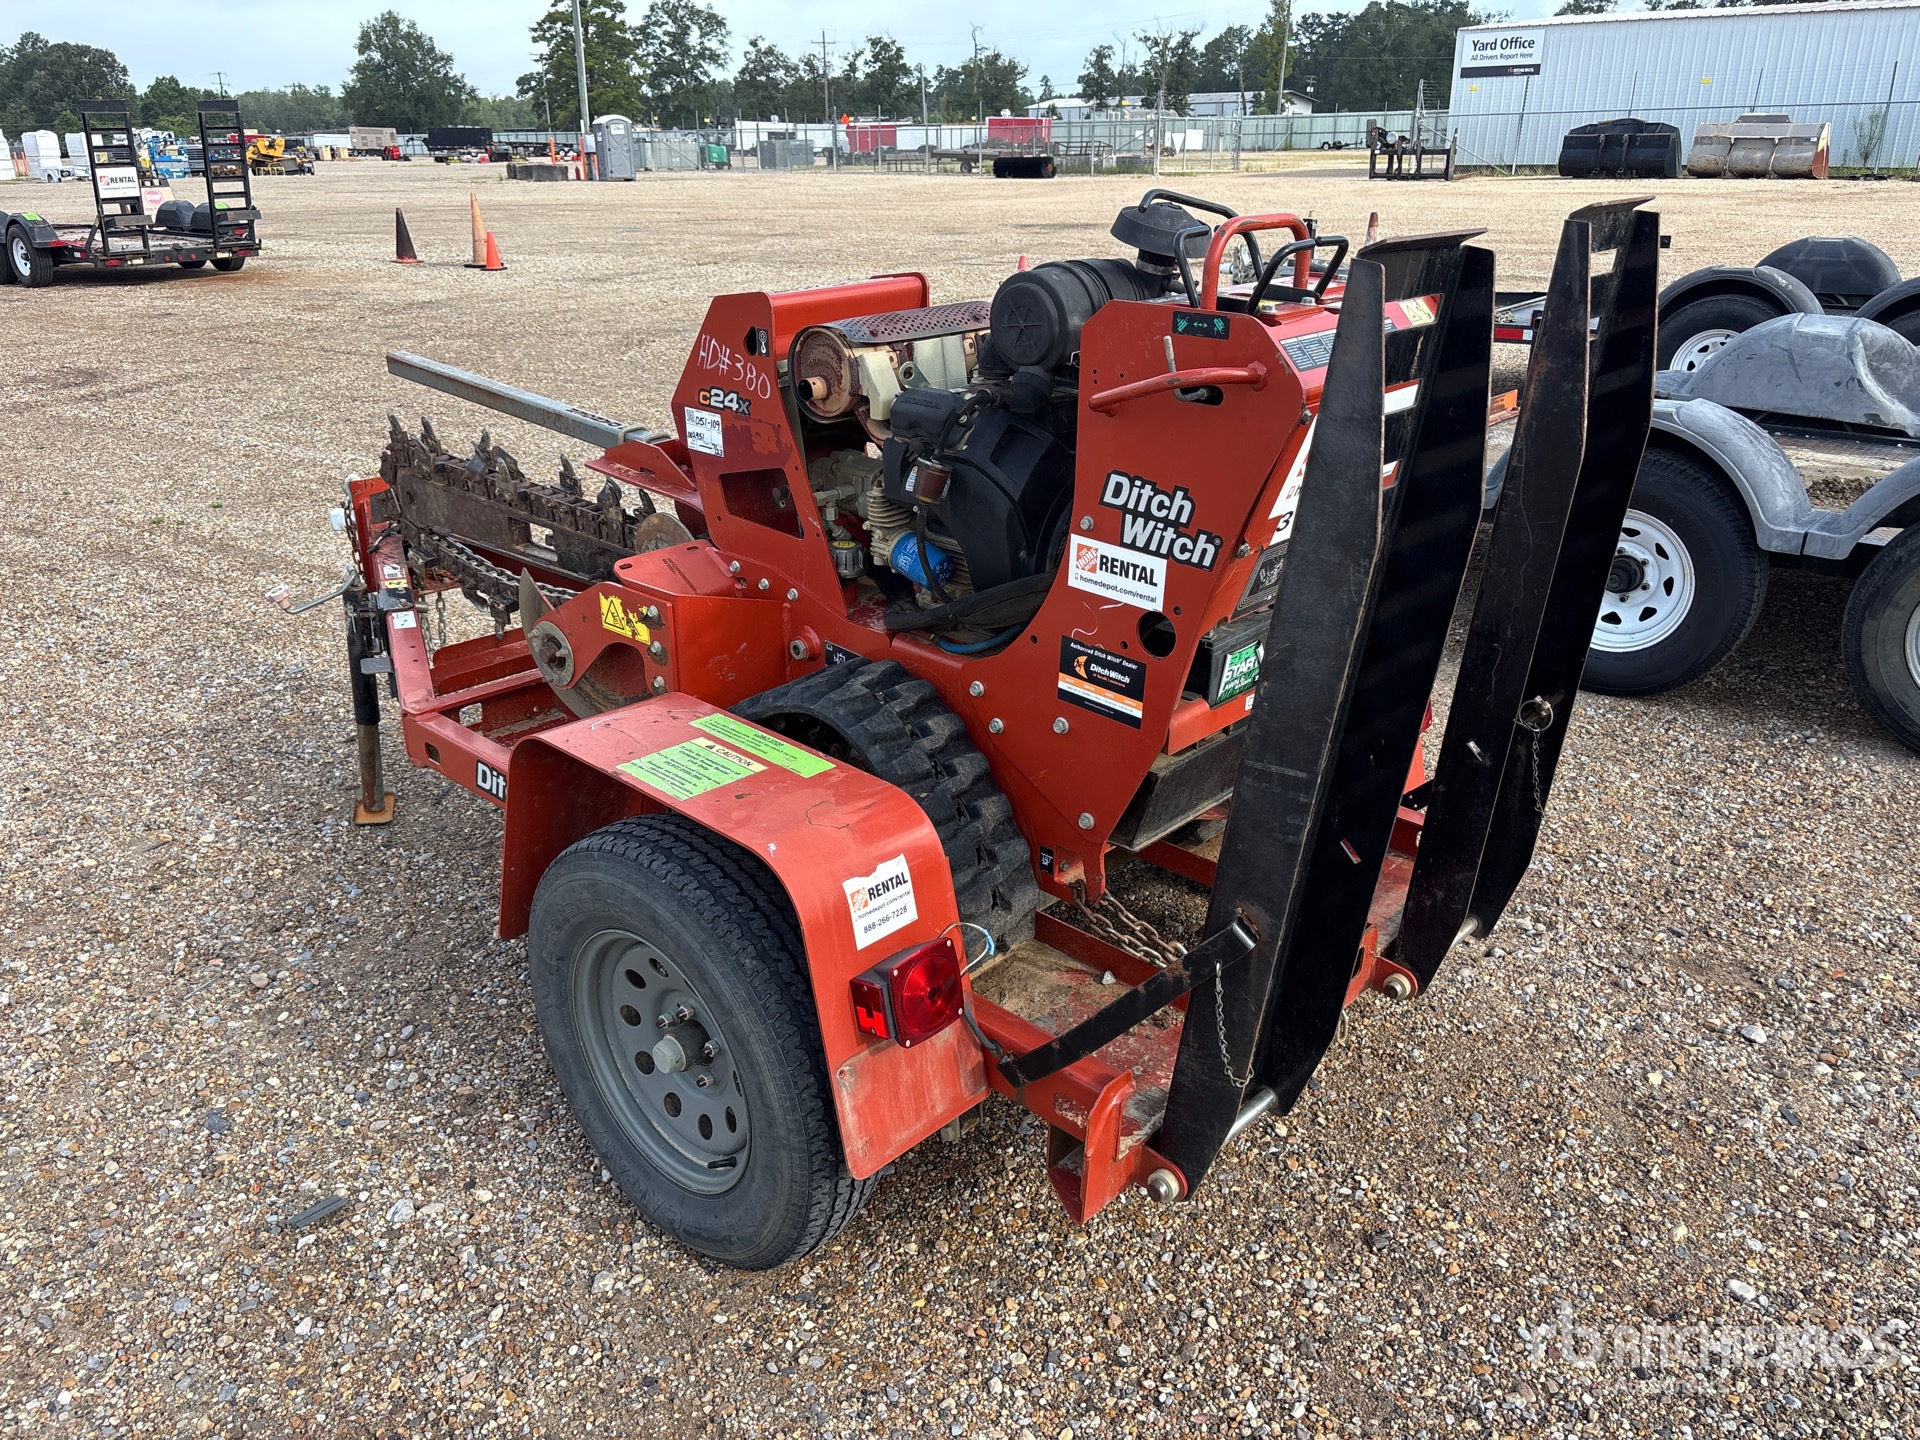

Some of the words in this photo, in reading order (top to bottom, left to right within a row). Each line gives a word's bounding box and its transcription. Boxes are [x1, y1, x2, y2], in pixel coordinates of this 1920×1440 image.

[1471, 53, 1479, 61] All
[1480, 53, 1499, 61] Drivers
[1500, 52, 1518, 61] Report
[1472, 38, 1498, 52] Yard
[1500, 36, 1535, 50] Office
[110, 175, 137, 184] RENTAL
[697, 333, 771, 399] HD#380
[1103, 473, 1193, 524] Ditch
[1099, 554, 1158, 588] RENTAL
[1079, 574, 1157, 604] homedepot.com/rental
[1094, 650, 1107, 659] Ditch
[1122, 660, 1138, 670] Dealer
[716, 748, 754, 767] CAUTION
[477, 761, 508, 799] Dit
[868, 871, 909, 902] RENTAL
[863, 905, 908, 934] 888-266-7228
